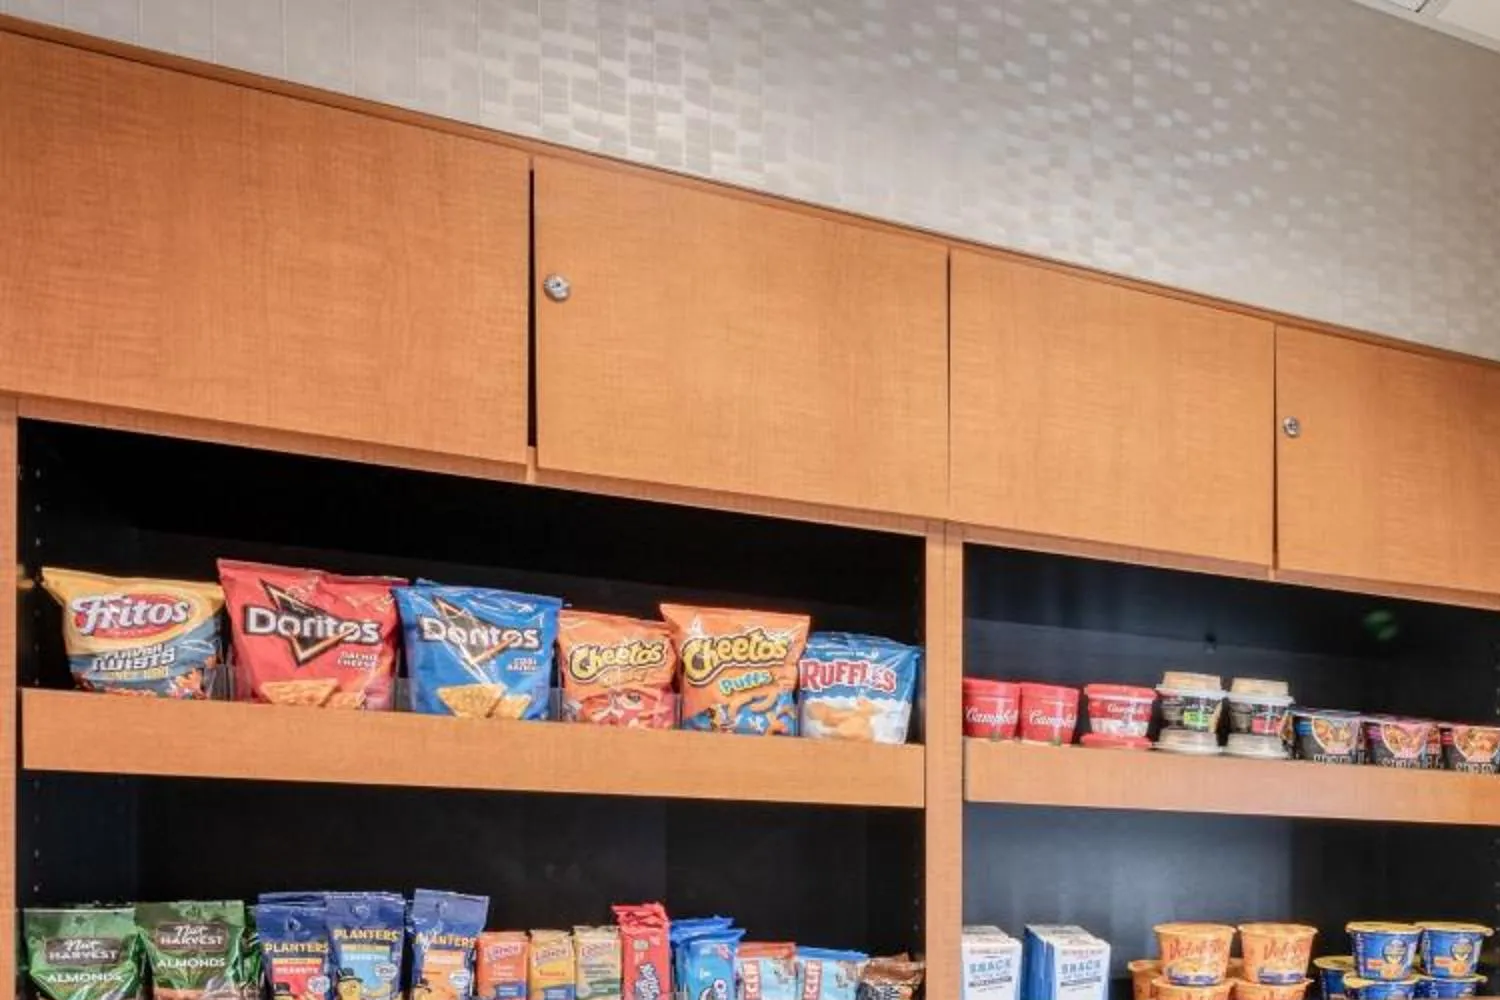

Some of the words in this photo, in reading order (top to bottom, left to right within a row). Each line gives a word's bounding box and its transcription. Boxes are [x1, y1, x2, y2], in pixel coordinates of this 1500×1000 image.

[72, 591, 191, 635] Fritos
[245, 606, 381, 644] Doritos
[420, 615, 541, 649] Doritos
[569, 639, 666, 682] Cheetos
[682, 630, 791, 682] Cheetos
[719, 670, 773, 696] Puffs
[800, 659, 897, 692] RUFFLES
[158, 934, 226, 946] HARVEST
[333, 928, 399, 942] PLANTERS
[415, 931, 477, 949] PLANTERS
[48, 950, 120, 961] HARVEST
[263, 941, 330, 953] PLANTERS
[157, 957, 227, 969] ALMONDS
[46, 971, 124, 984] ALMONDS
